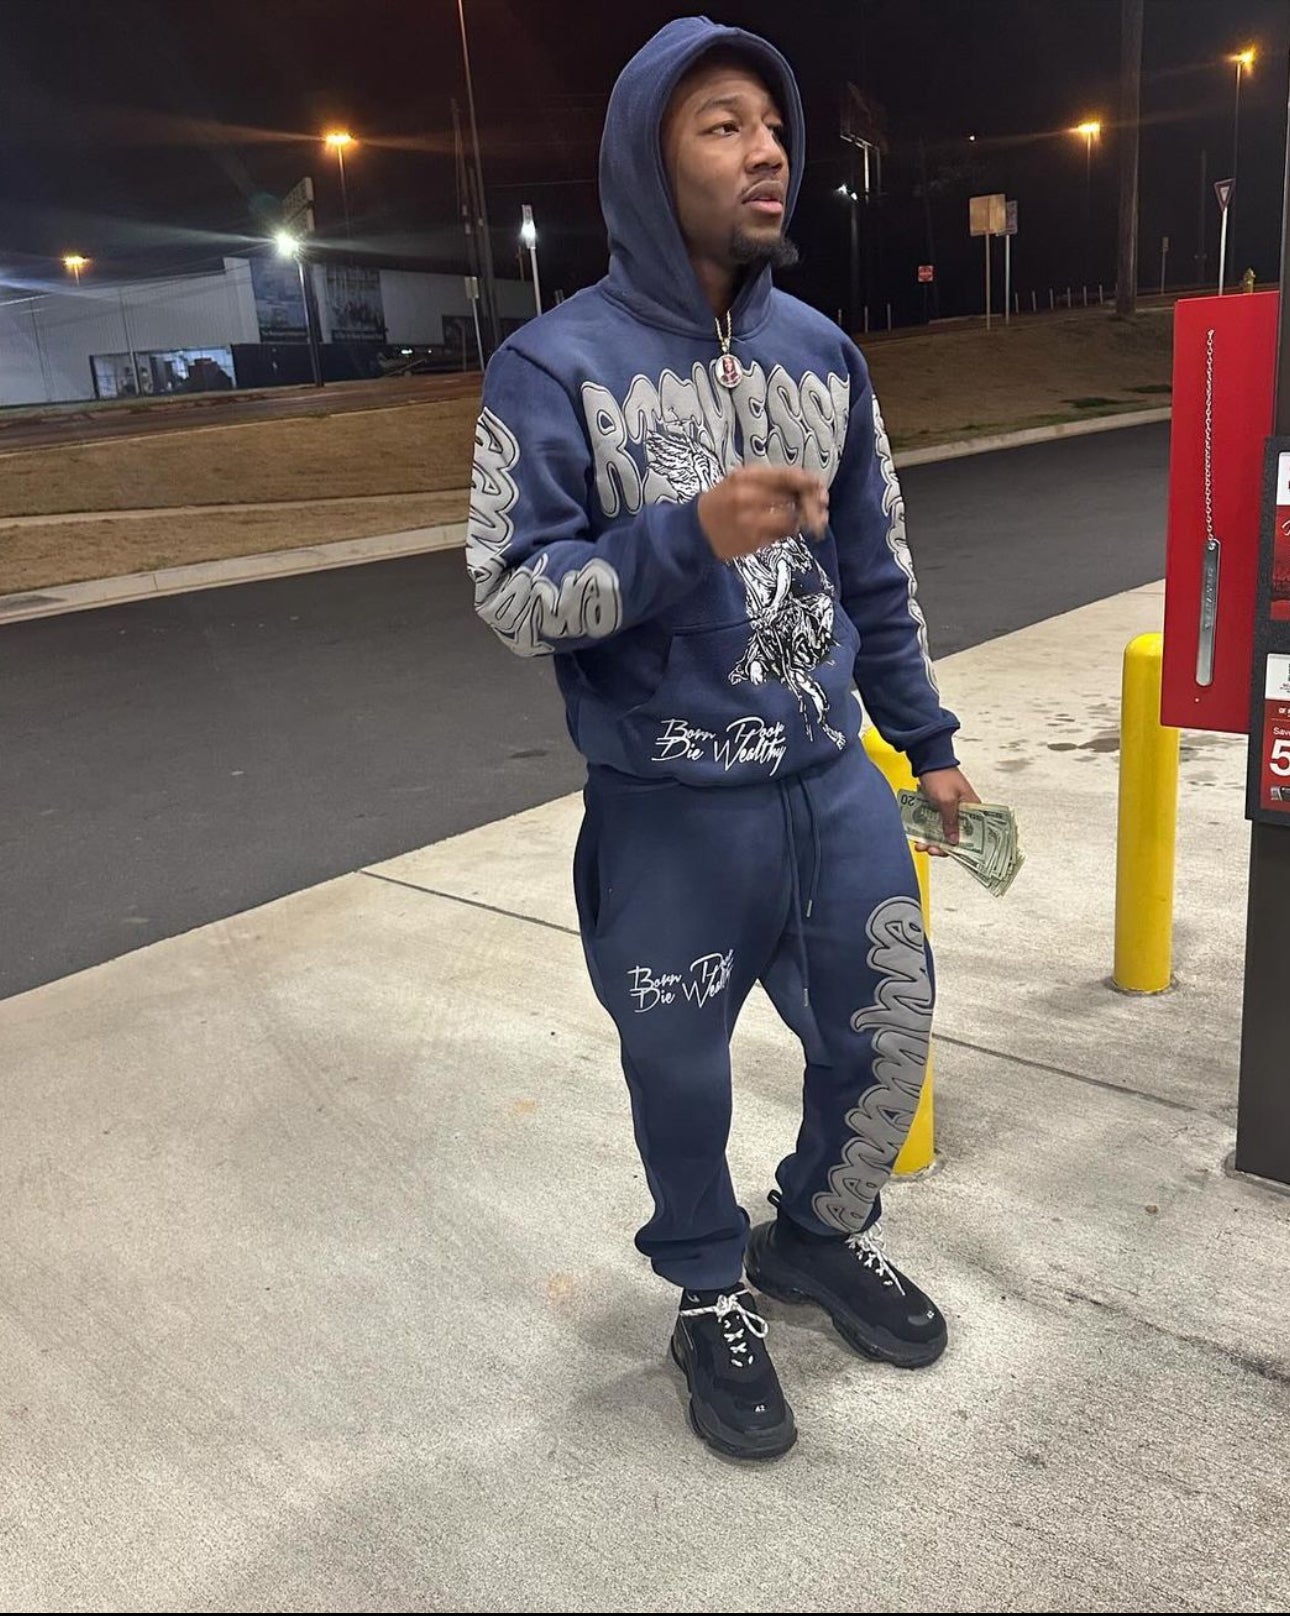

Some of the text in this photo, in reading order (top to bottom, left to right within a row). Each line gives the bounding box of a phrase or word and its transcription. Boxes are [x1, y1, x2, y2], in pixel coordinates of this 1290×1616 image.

[657, 716, 785, 743] Born Poor
[651, 736, 787, 776] Die Wealthy
[901, 794, 916, 807] 20
[627, 965, 682, 994] Born
[629, 986, 676, 1013] Die
